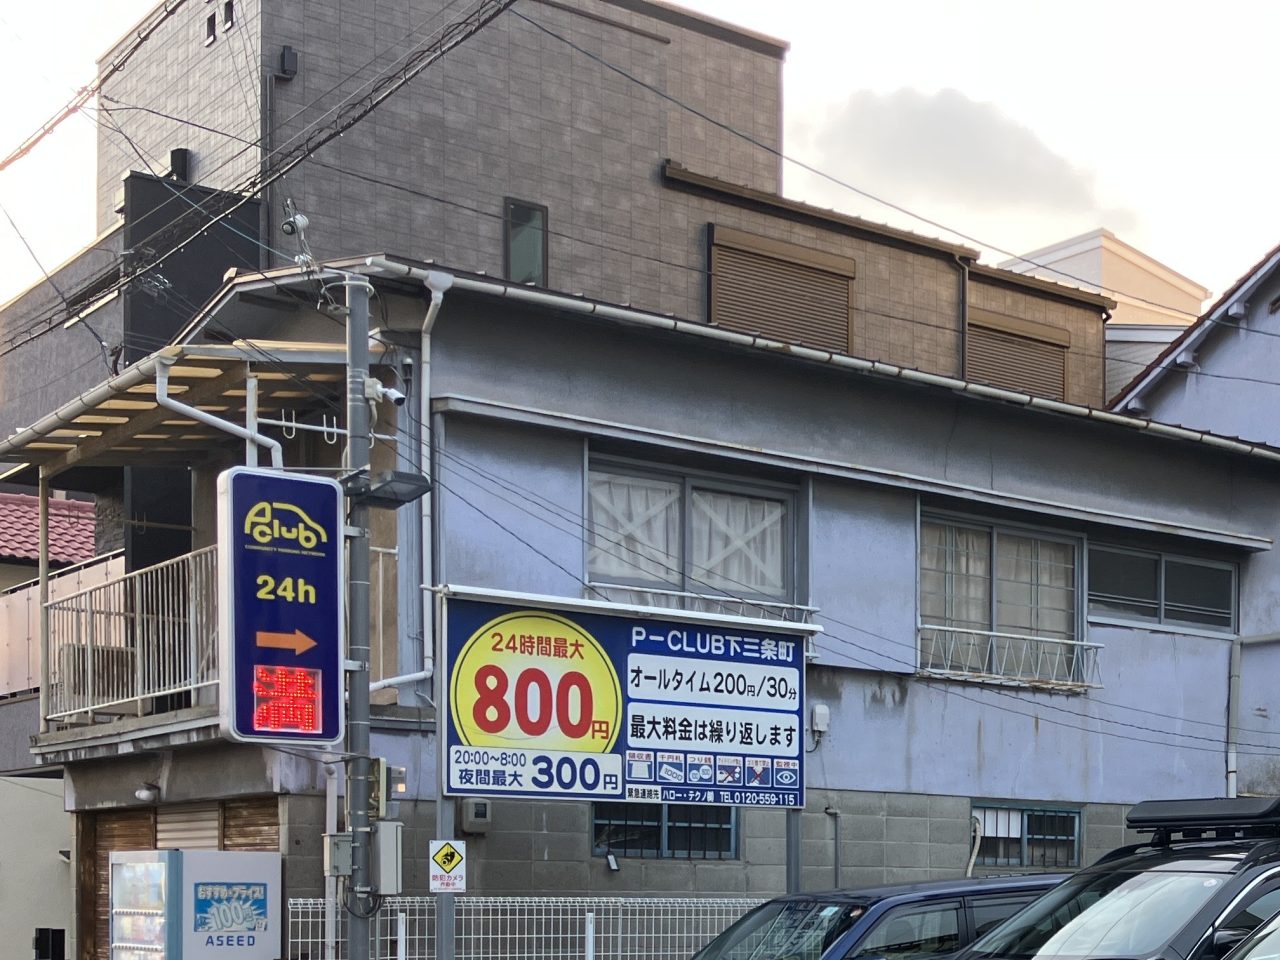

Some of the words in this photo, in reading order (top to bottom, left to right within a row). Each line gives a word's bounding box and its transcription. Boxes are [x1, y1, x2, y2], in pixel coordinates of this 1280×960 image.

[256, 574, 316, 604] 24h
[491, 632, 585, 660] 24時間最大
[630, 714, 797, 748] 最大料金は繰り返します
[458, 769, 523, 788] 夜間最大
[734, 792, 795, 806] 0120-559-115
[205, 935, 256, 947] ASEED
